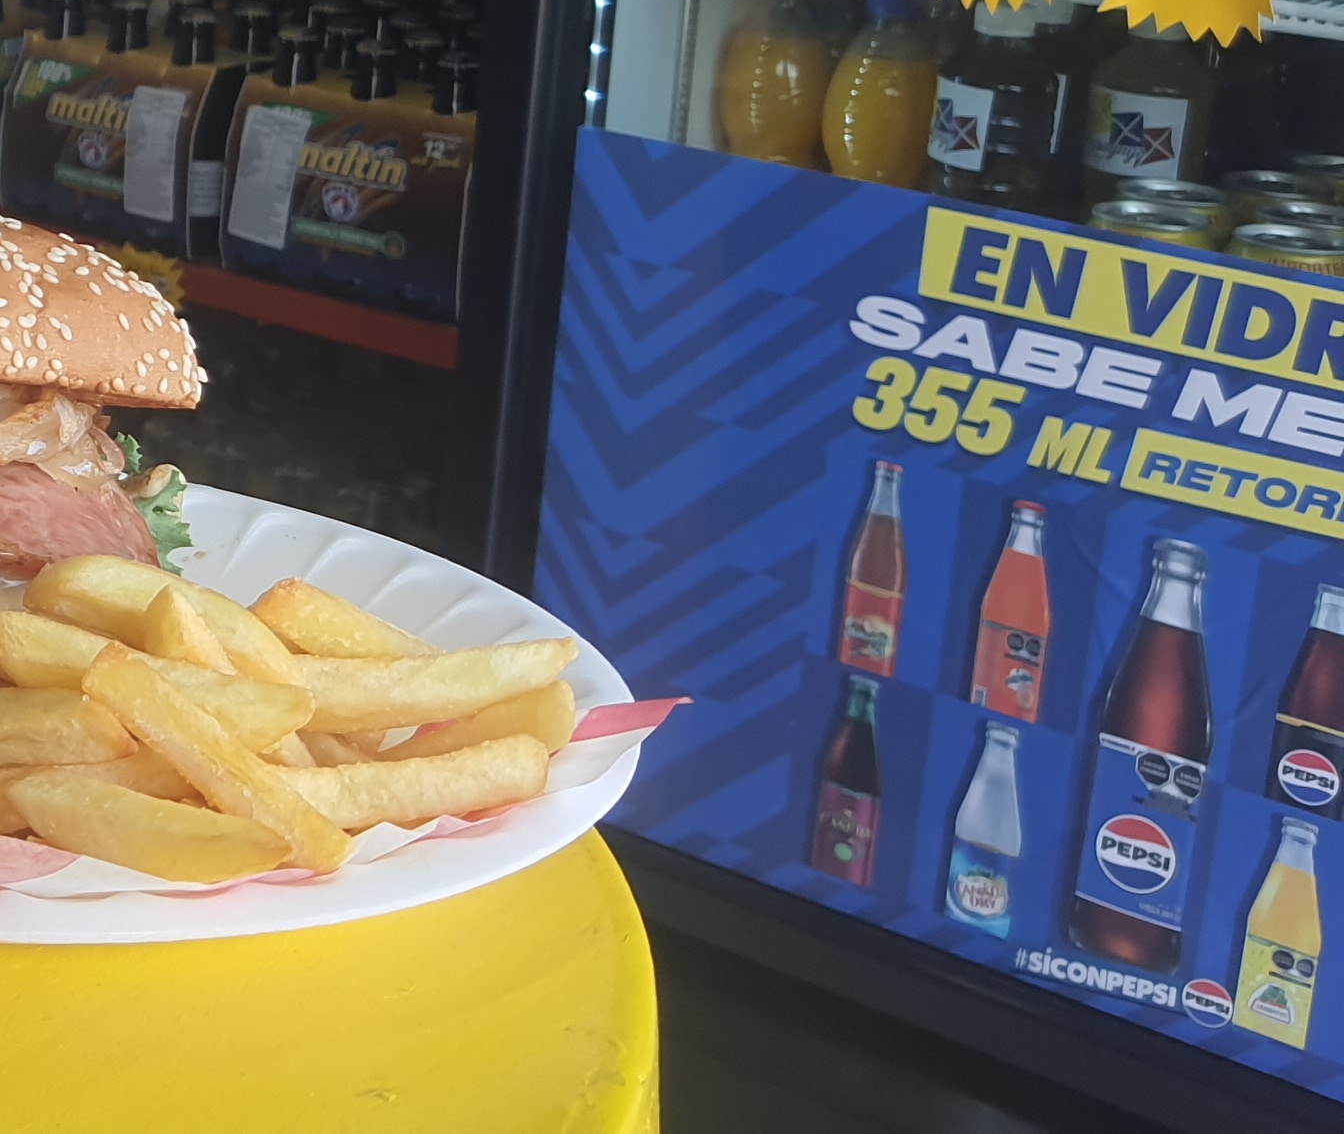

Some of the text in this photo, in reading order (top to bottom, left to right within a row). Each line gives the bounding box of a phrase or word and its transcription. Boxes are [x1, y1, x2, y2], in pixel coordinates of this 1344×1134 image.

[949, 225, 1088, 320] EN
[849, 295, 1344, 458] SABE ME
[852, 356, 1028, 456] 355
[1026, 415, 1113, 484] ML
[1279, 764, 1335, 793] PEPSI
[1100, 835, 1172, 873] PEPSI
[1185, 990, 1230, 1016] PEPSI
